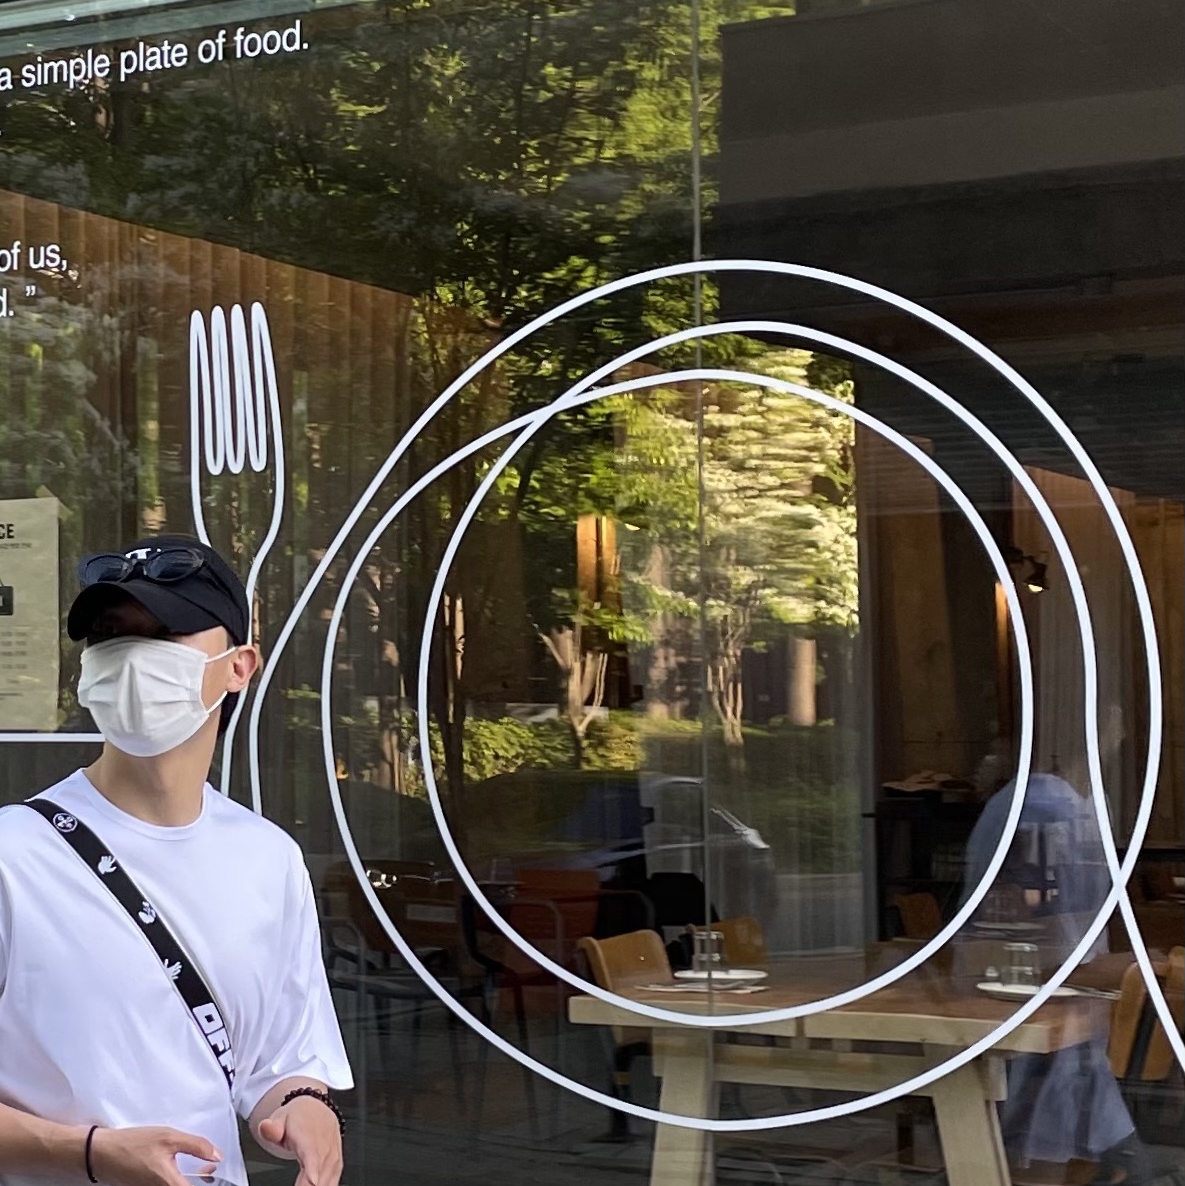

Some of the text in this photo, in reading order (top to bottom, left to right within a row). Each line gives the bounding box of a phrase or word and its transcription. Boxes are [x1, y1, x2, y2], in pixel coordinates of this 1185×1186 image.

[21, 48, 110, 88] simple
[120, 40, 188, 82] plate
[197, 30, 226, 63] of
[234, 19, 309, 58] food.
[29, 245, 67, 271] us,
